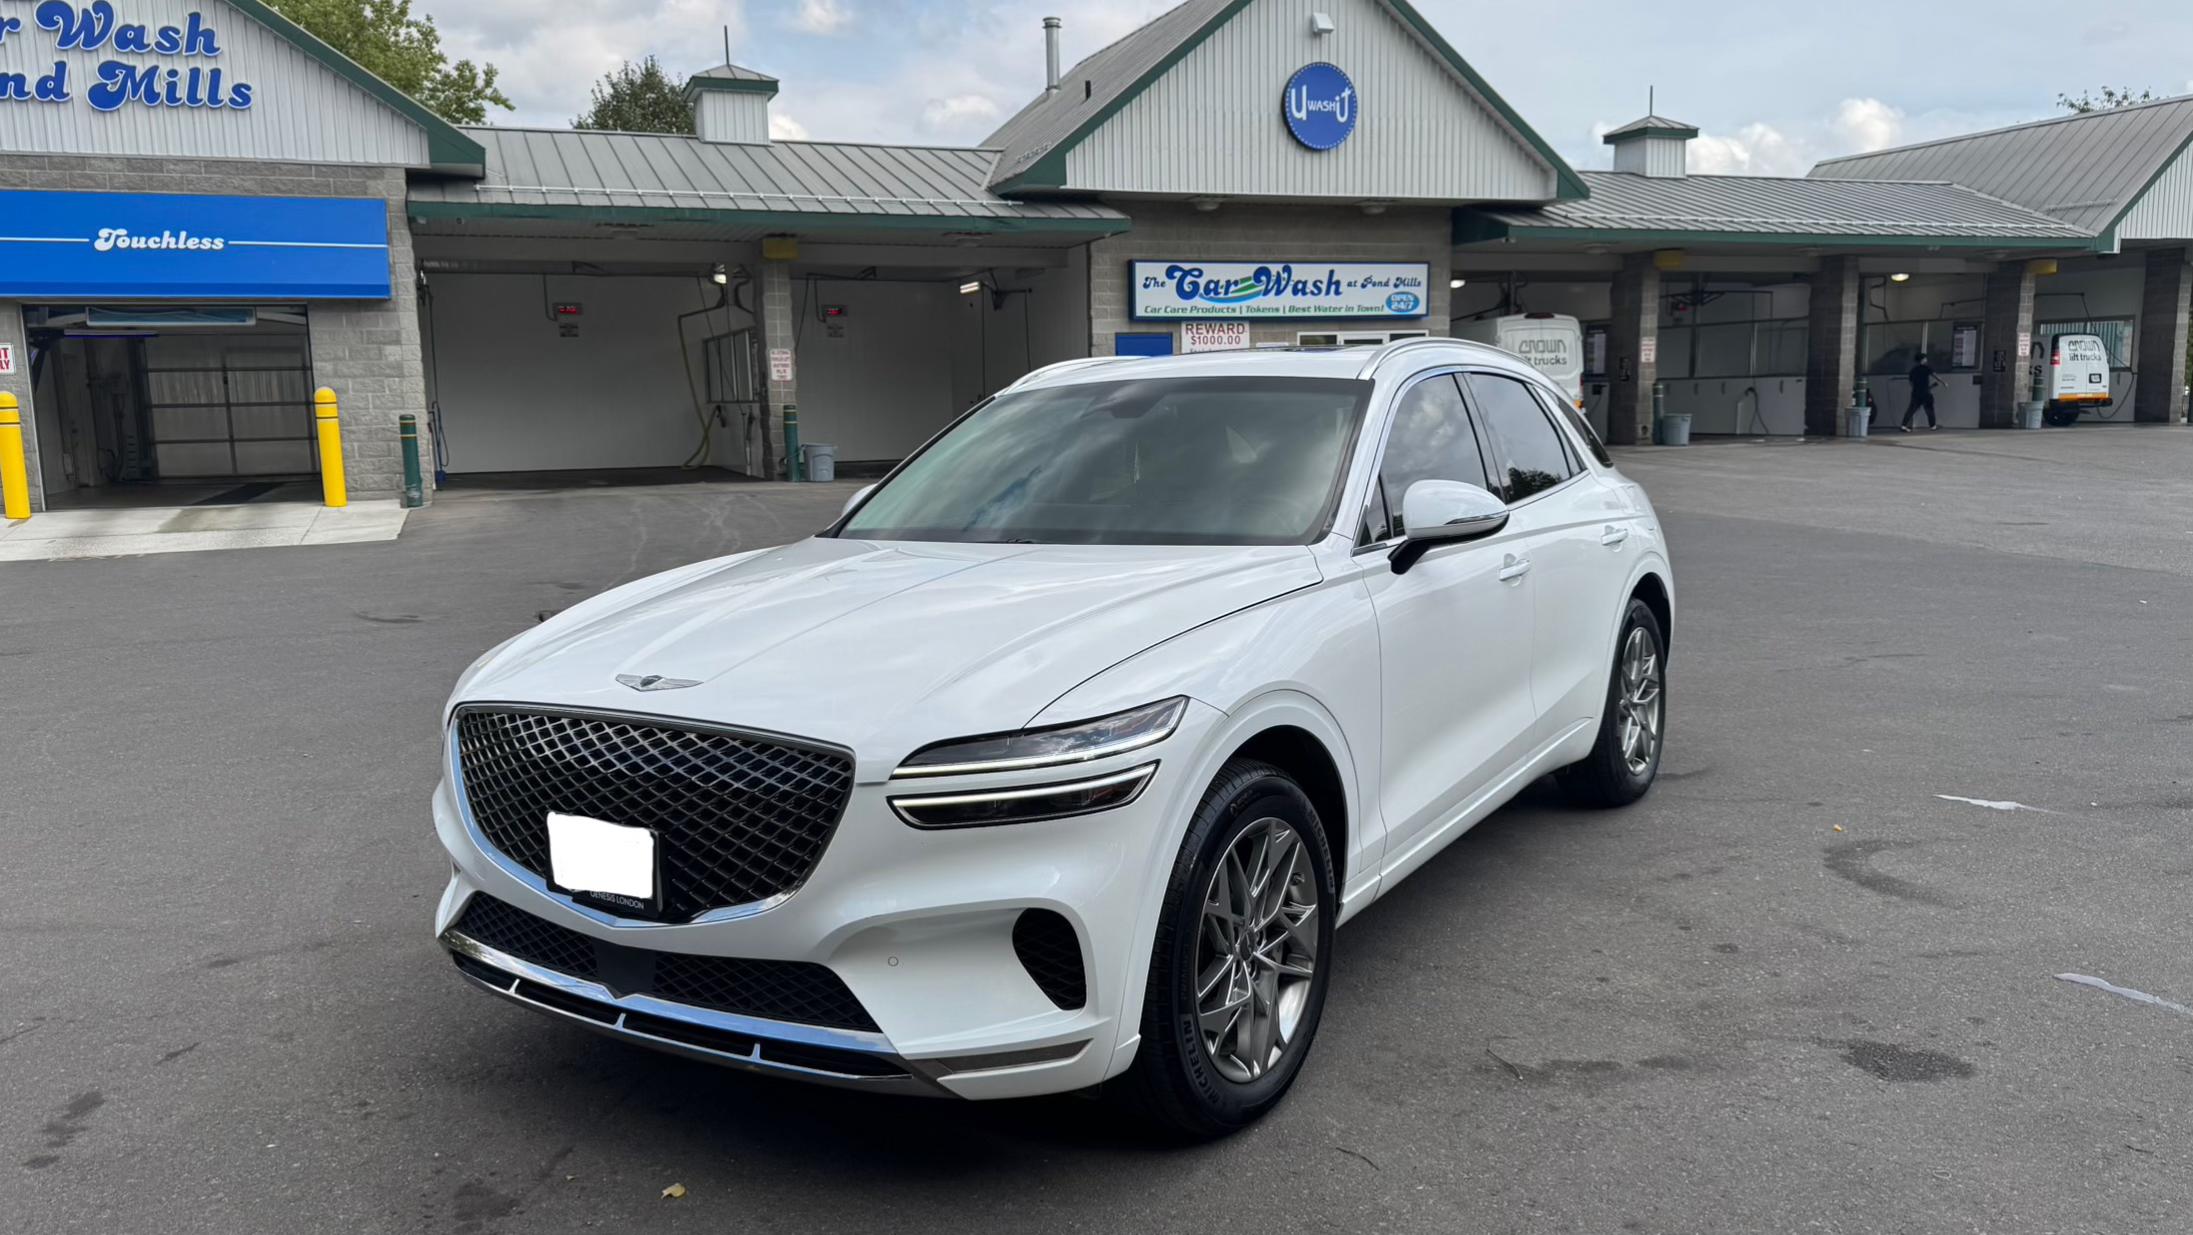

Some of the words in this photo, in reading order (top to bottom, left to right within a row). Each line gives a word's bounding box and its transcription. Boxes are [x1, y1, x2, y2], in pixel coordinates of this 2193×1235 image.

[34, 0, 221, 56] Wash
[0, 60, 72, 102] nd
[86, 59, 252, 112] Mills
[94, 227, 225, 252] Touchless
[1142, 276, 1166, 289] The
[1165, 264, 1239, 301] Car
[1252, 264, 1343, 297] Wash
[1346, 279, 1358, 288] at
[1360, 274, 1390, 289] Pond
[1393, 276, 1421, 289] Mills
[1144, 305, 1162, 314] Car
[1164, 305, 1188, 314] Care
[1189, 305, 1237, 314] Products
[1245, 305, 1280, 314] Tokens
[1288, 305, 1311, 313] Best
[1314, 305, 1342, 313] Water
[1345, 304, 1354, 312] in
[1356, 304, 1385, 313] Town!
[1185, 323, 1245, 335] REWARD
[1191, 335, 1241, 346] $1000.00
[1533, 355, 1567, 366] trucks
[616, 896, 645, 910] LONDON
[1182, 1019, 1220, 1104] MICHELIN
